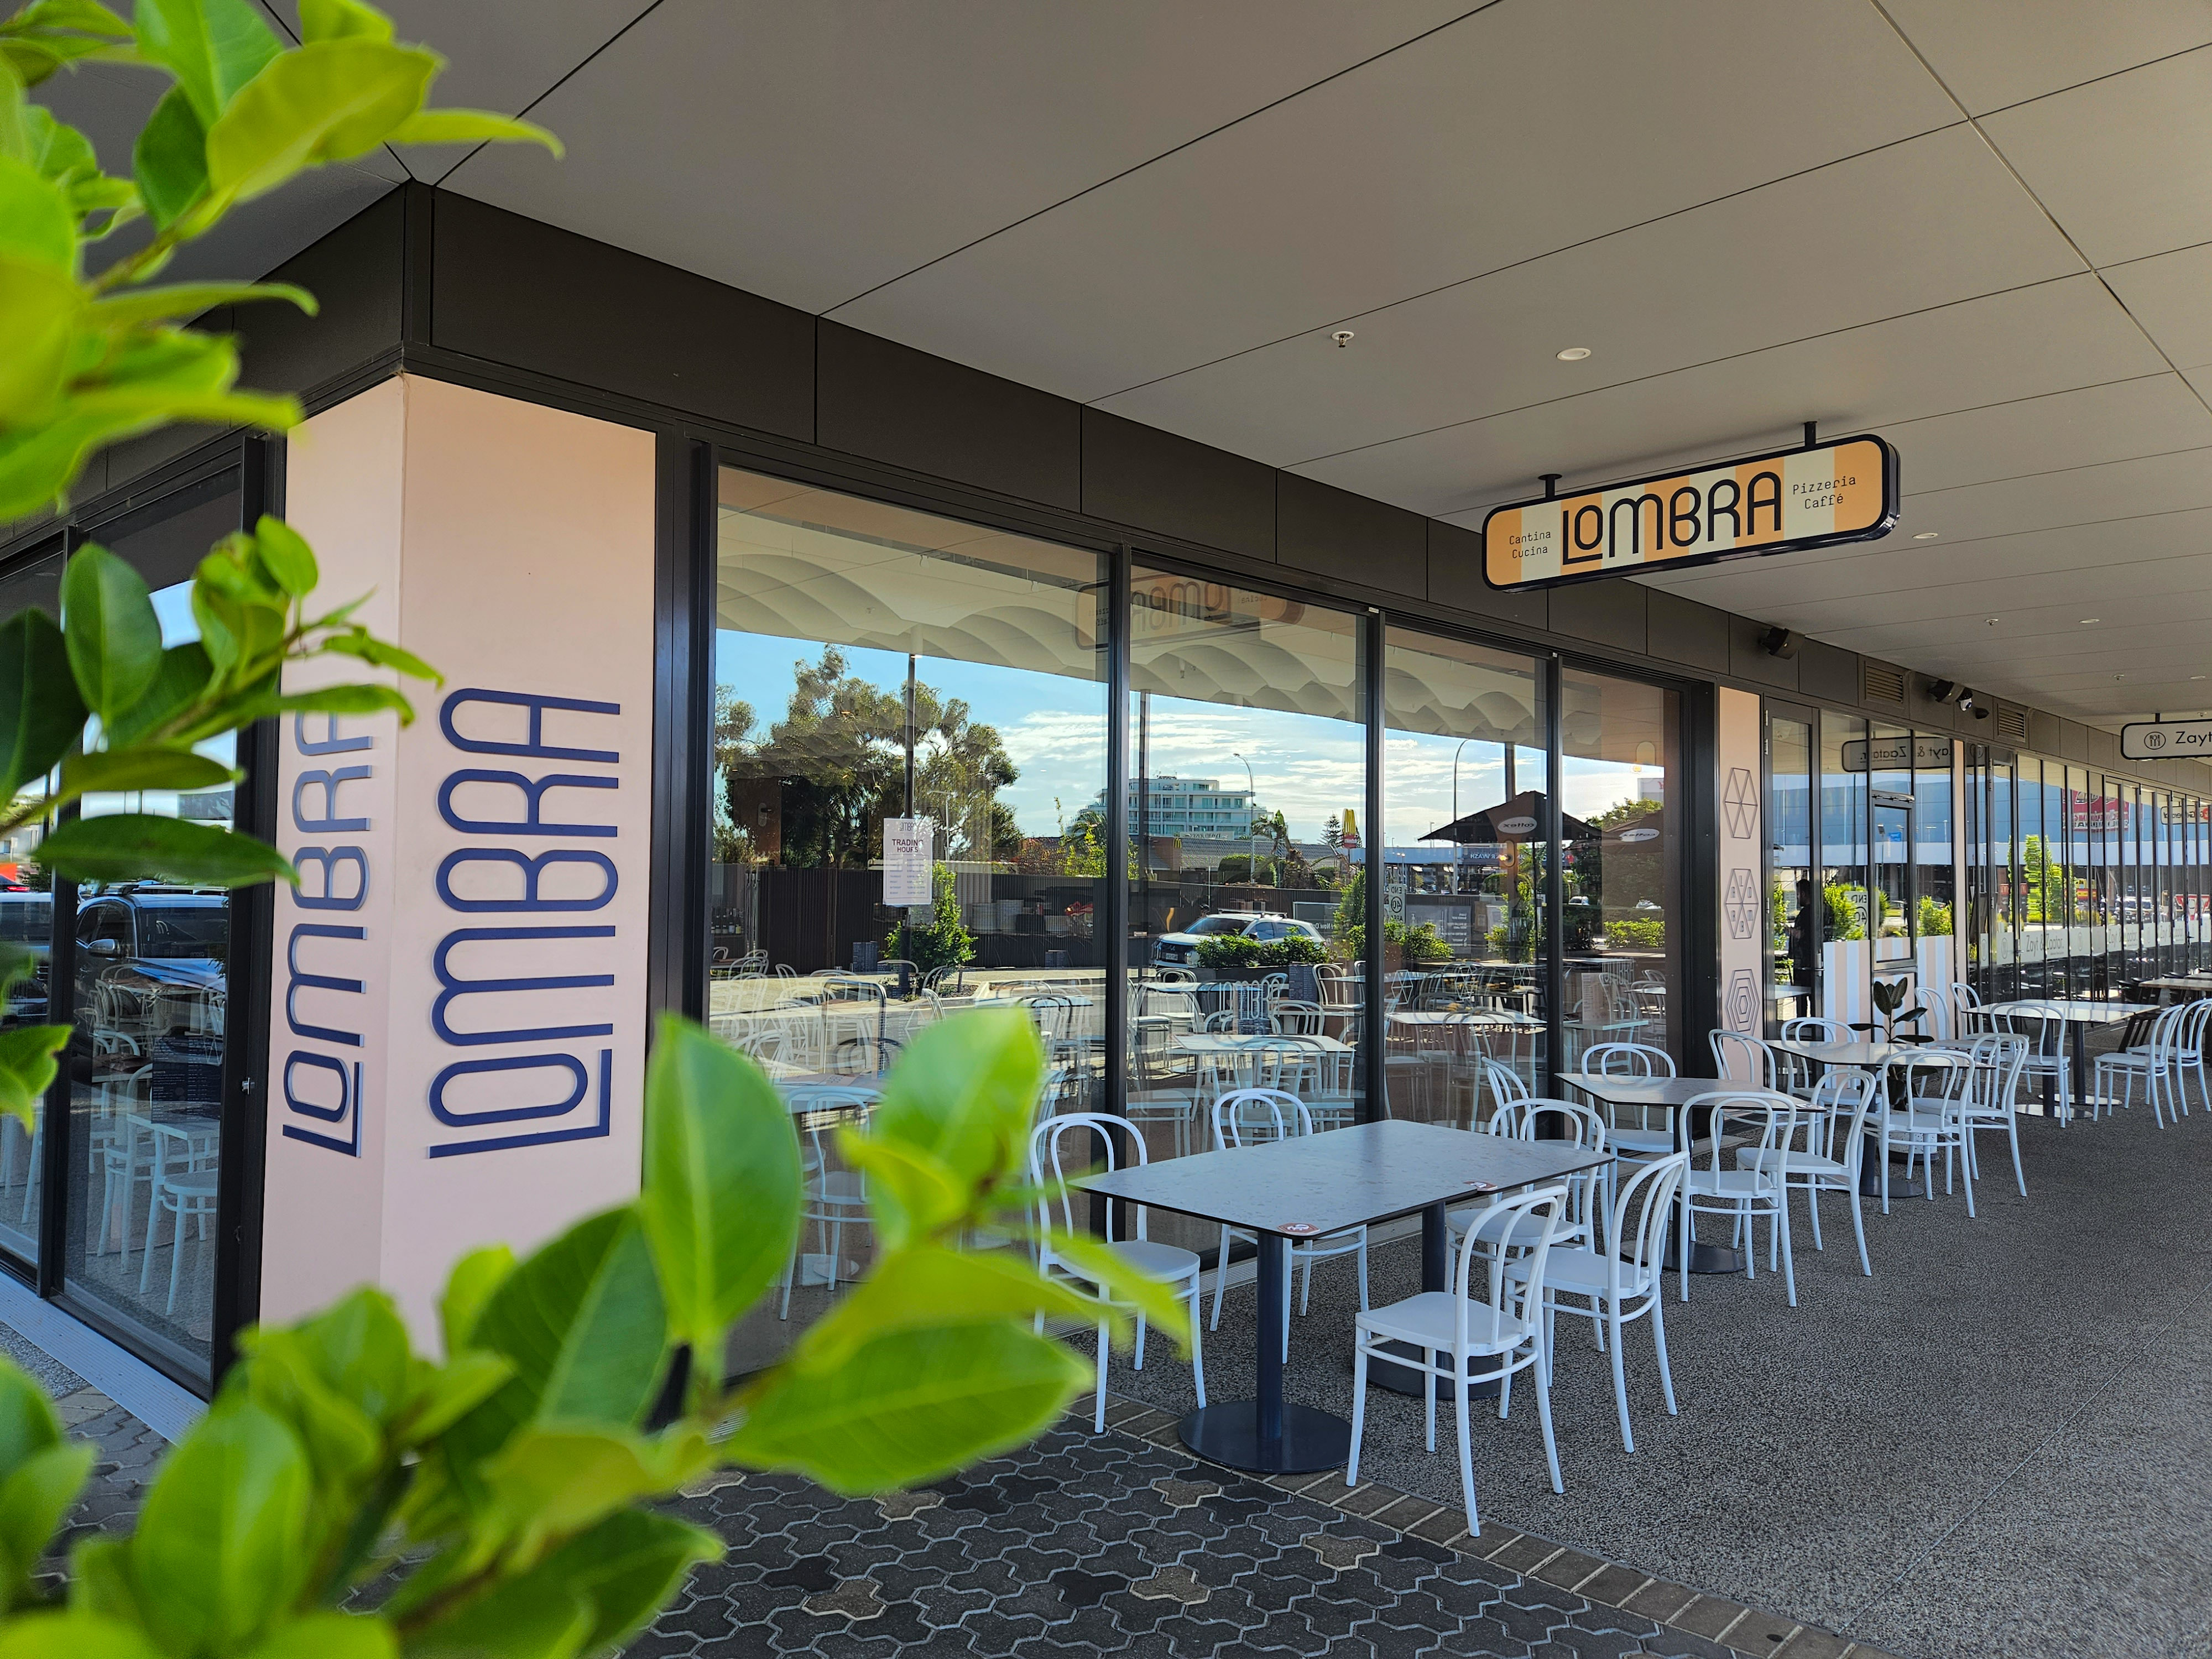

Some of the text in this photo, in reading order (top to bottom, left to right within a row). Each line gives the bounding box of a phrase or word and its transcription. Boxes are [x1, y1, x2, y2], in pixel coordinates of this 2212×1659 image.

[1793, 476, 1856, 495] Pizzeria
[1805, 493, 1844, 509] Caffé
[1563, 472, 1781, 565] LOMBRA
[1509, 531, 1551, 545] Cantina
[1512, 546, 1548, 559] Cucina
[2176, 731, 2212, 747] Zayt
[427, 688, 620, 1159] LOMBRA
[2026, 935, 2039, 957] Zayt
